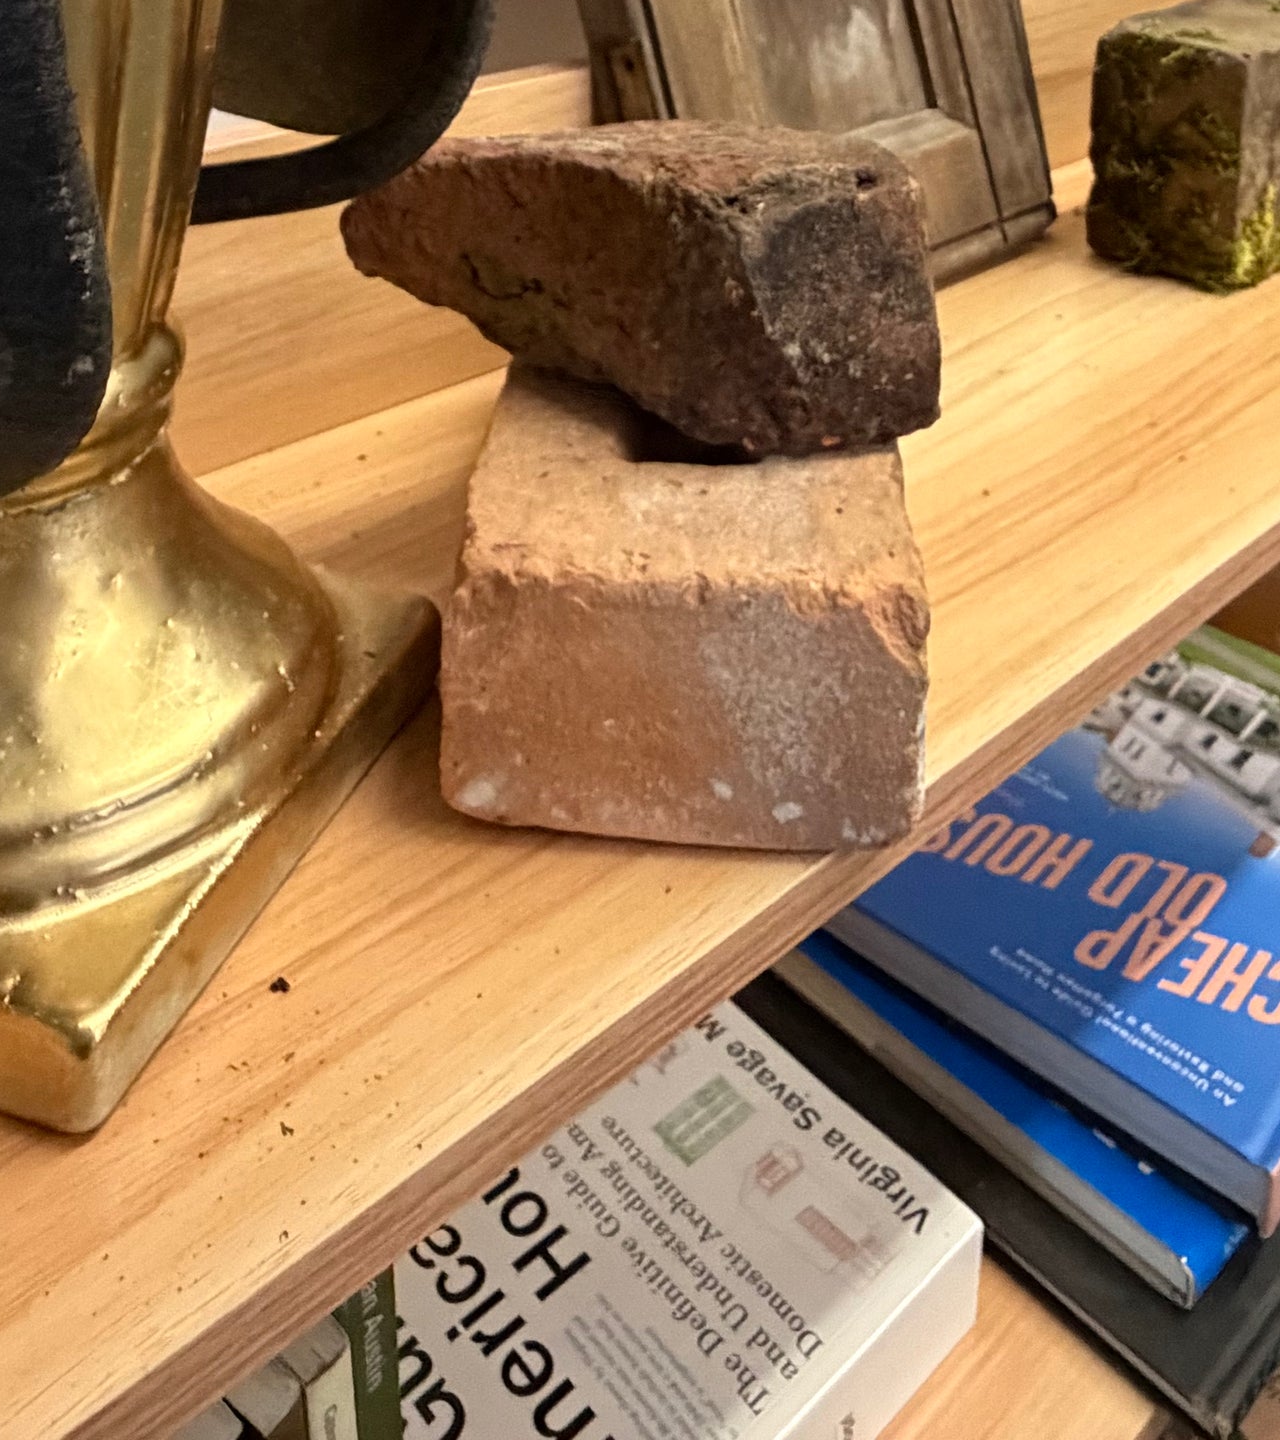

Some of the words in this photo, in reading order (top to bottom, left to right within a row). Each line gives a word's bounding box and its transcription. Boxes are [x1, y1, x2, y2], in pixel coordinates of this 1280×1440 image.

[1087, 851, 1228, 928] OLD
[726, 1040, 822, 1131] Savage
[1094, 1015, 1210, 1093] Unconventional
[1140, 1022, 1210, 1075] Restoring
[1211, 1069, 1245, 1094] and
[1212, 1088, 1238, 1108] An
[541, 1143, 566, 1171] to
[601, 1114, 724, 1245] Architecture
[822, 1128, 930, 1235] Virginia
[562, 1168, 620, 1239] Guide
[600, 1160, 750, 1332] Understanding
[621, 1236, 726, 1358] Definitive
[721, 1242, 824, 1361] Domestic
[724, 1352, 770, 1416] The
[745, 1325, 800, 1381] and
